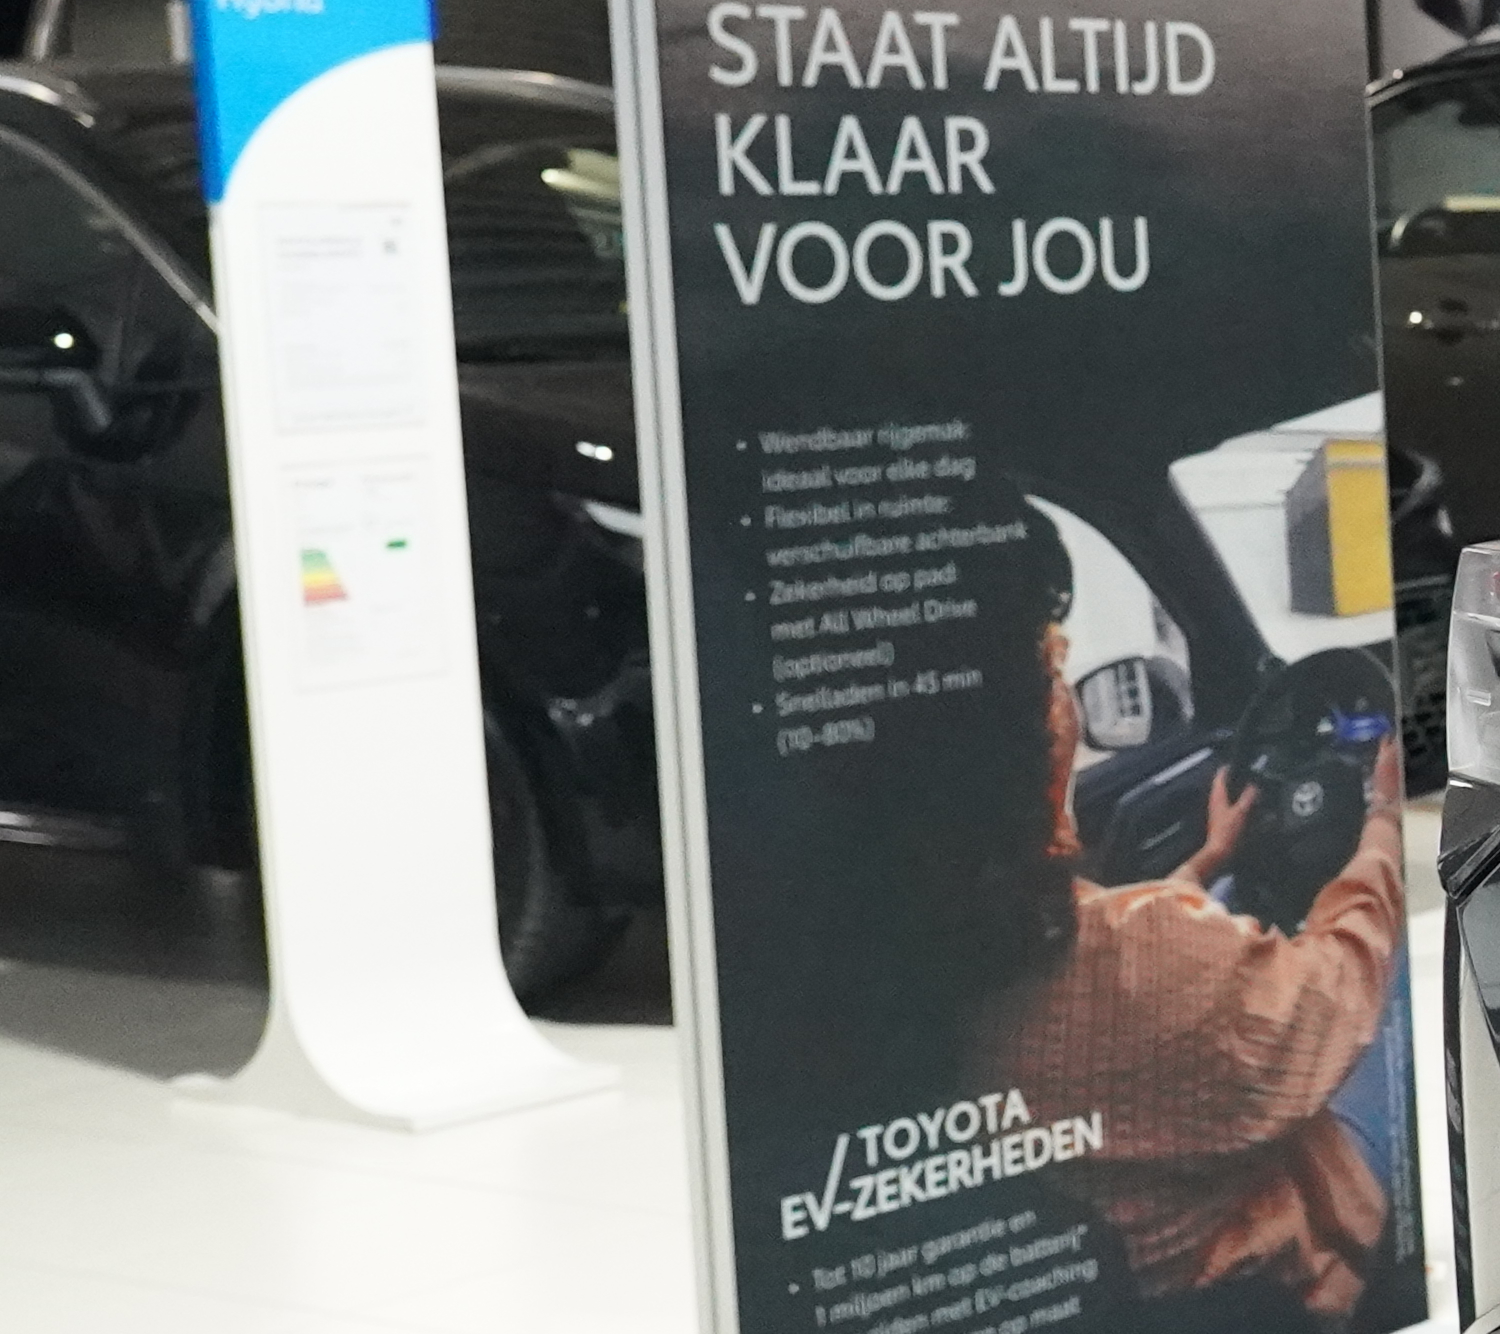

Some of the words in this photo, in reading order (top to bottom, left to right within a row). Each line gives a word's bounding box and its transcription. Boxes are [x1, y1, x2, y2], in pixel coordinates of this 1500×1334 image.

[706, 2, 960, 90] STAAT
[983, 15, 1216, 96] ALTIJD
[714, 115, 996, 196] KLAAR
[714, 220, 978, 305] VOOR
[998, 216, 1151, 297] JOU
[758, 427, 873, 453] Wendbaar
[762, 465, 833, 492] ideaal
[834, 466, 882, 485] voor
[886, 457, 931, 482] elke
[933, 456, 976, 481] dag
[765, 502, 850, 529] Flexibel
[915, 521, 1028, 551] achterbank
[769, 571, 877, 605] Zekerheid
[879, 572, 911, 592] op
[913, 564, 957, 591] pad
[771, 618, 815, 641] met
[851, 601, 921, 630] Wheel
[924, 599, 978, 623] Drive
[775, 683, 885, 716] Snelladen
[887, 680, 910, 698] in
[942, 668, 983, 691] min
[857, 1088, 1031, 1167] TOYOTA
[781, 1112, 1104, 1241] EV-ZEKERHEDEN
[812, 1266, 846, 1291] Tot
[877, 1247, 918, 1277] jaar
[920, 1219, 1006, 1265] garantie
[1009, 1210, 1036, 1233] en
[829, 1285, 911, 1323] miljoen
[912, 1272, 946, 1296] km
[948, 1263, 977, 1286] op
[979, 1252, 1009, 1276] de
[931, 1297, 973, 1324] met
[974, 1259, 1098, 1314] EV-coaching
[1030, 1296, 1081, 1326] maat
